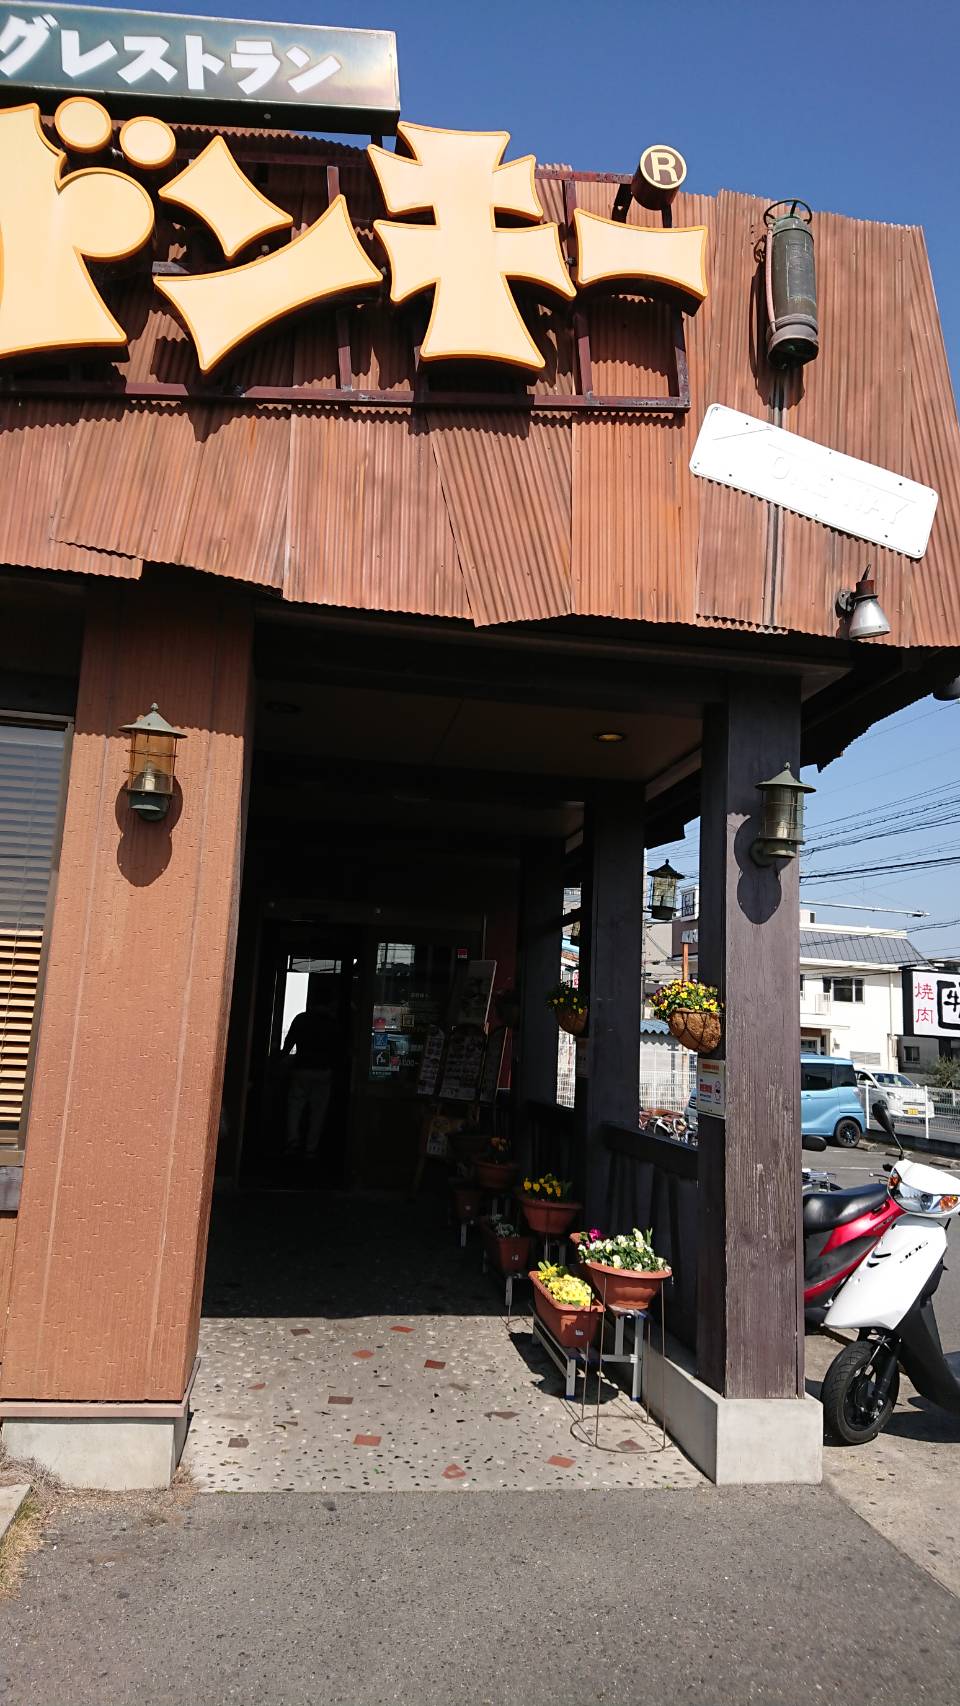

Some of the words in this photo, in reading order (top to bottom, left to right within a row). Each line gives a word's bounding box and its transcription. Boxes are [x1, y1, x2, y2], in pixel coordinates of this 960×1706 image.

[0, 14, 341, 95] グレストラン
[0, 97, 708, 373] ドンキー
[915, 982, 934, 1024] 焼肉
